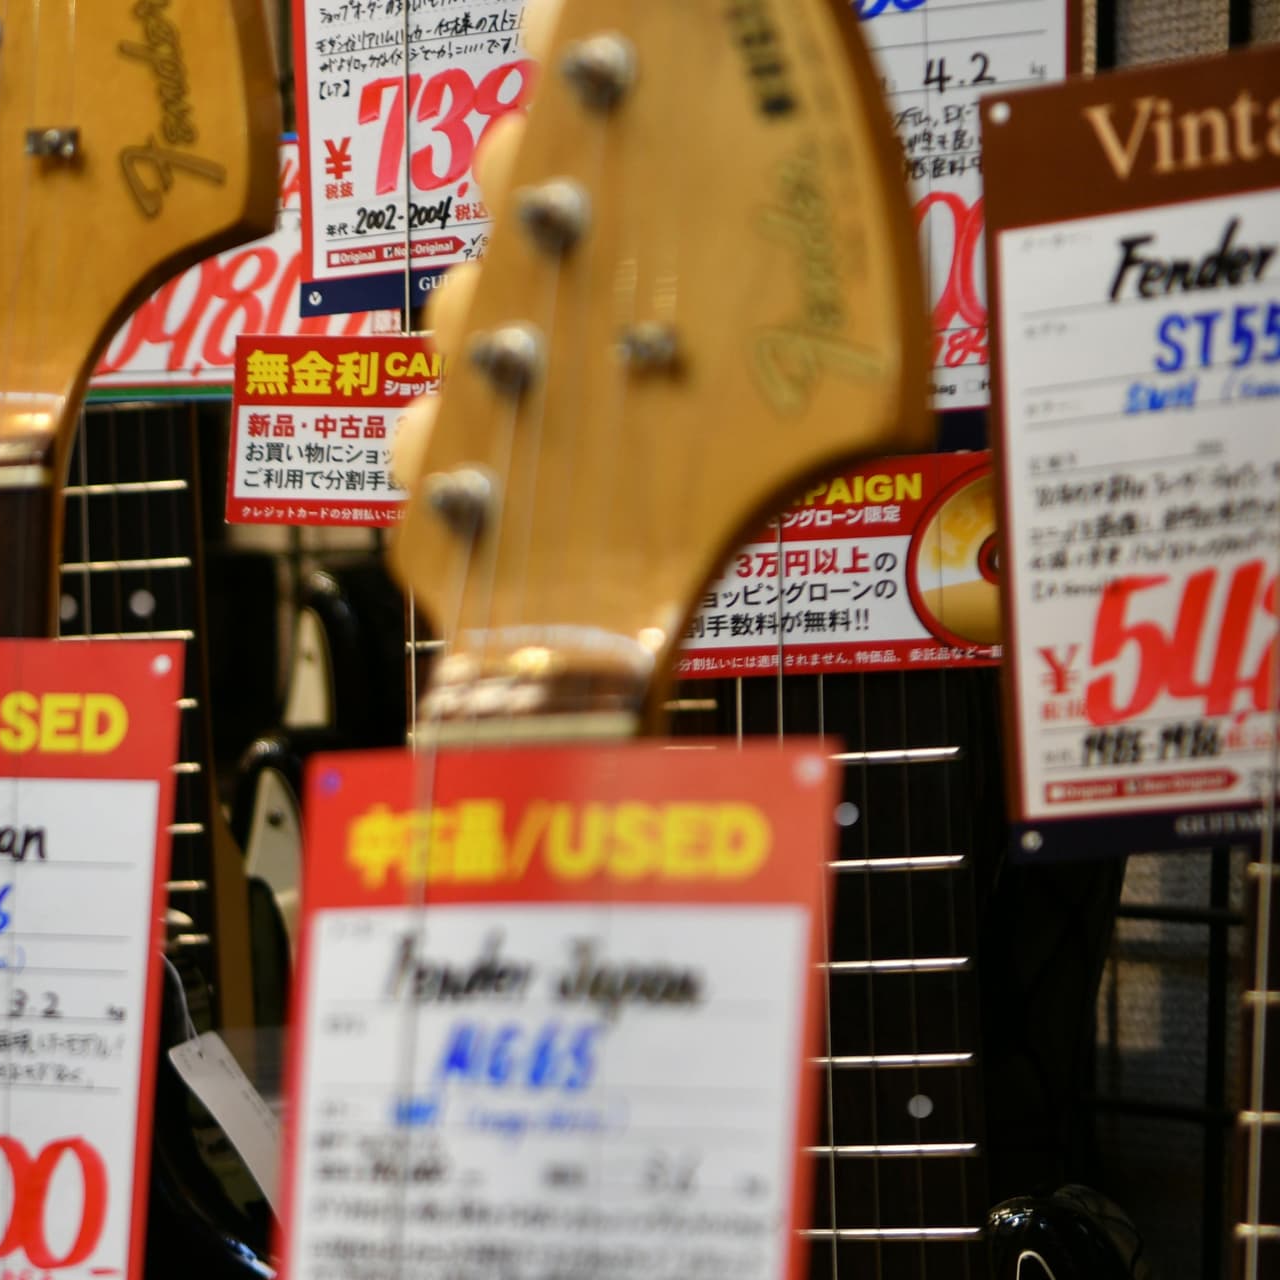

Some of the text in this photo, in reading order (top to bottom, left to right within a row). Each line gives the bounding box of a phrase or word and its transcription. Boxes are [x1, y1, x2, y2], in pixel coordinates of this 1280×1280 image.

[923, 51, 996, 93] 4.2
[324, 137, 352, 180] ¥
[355, 196, 453, 234] 2002-2004
[341, 240, 454, 263] Original No-Original
[1108, 213, 1280, 303] Fender
[246, 349, 380, 397] 無金利
[735, 546, 897, 579] 3万円以上の
